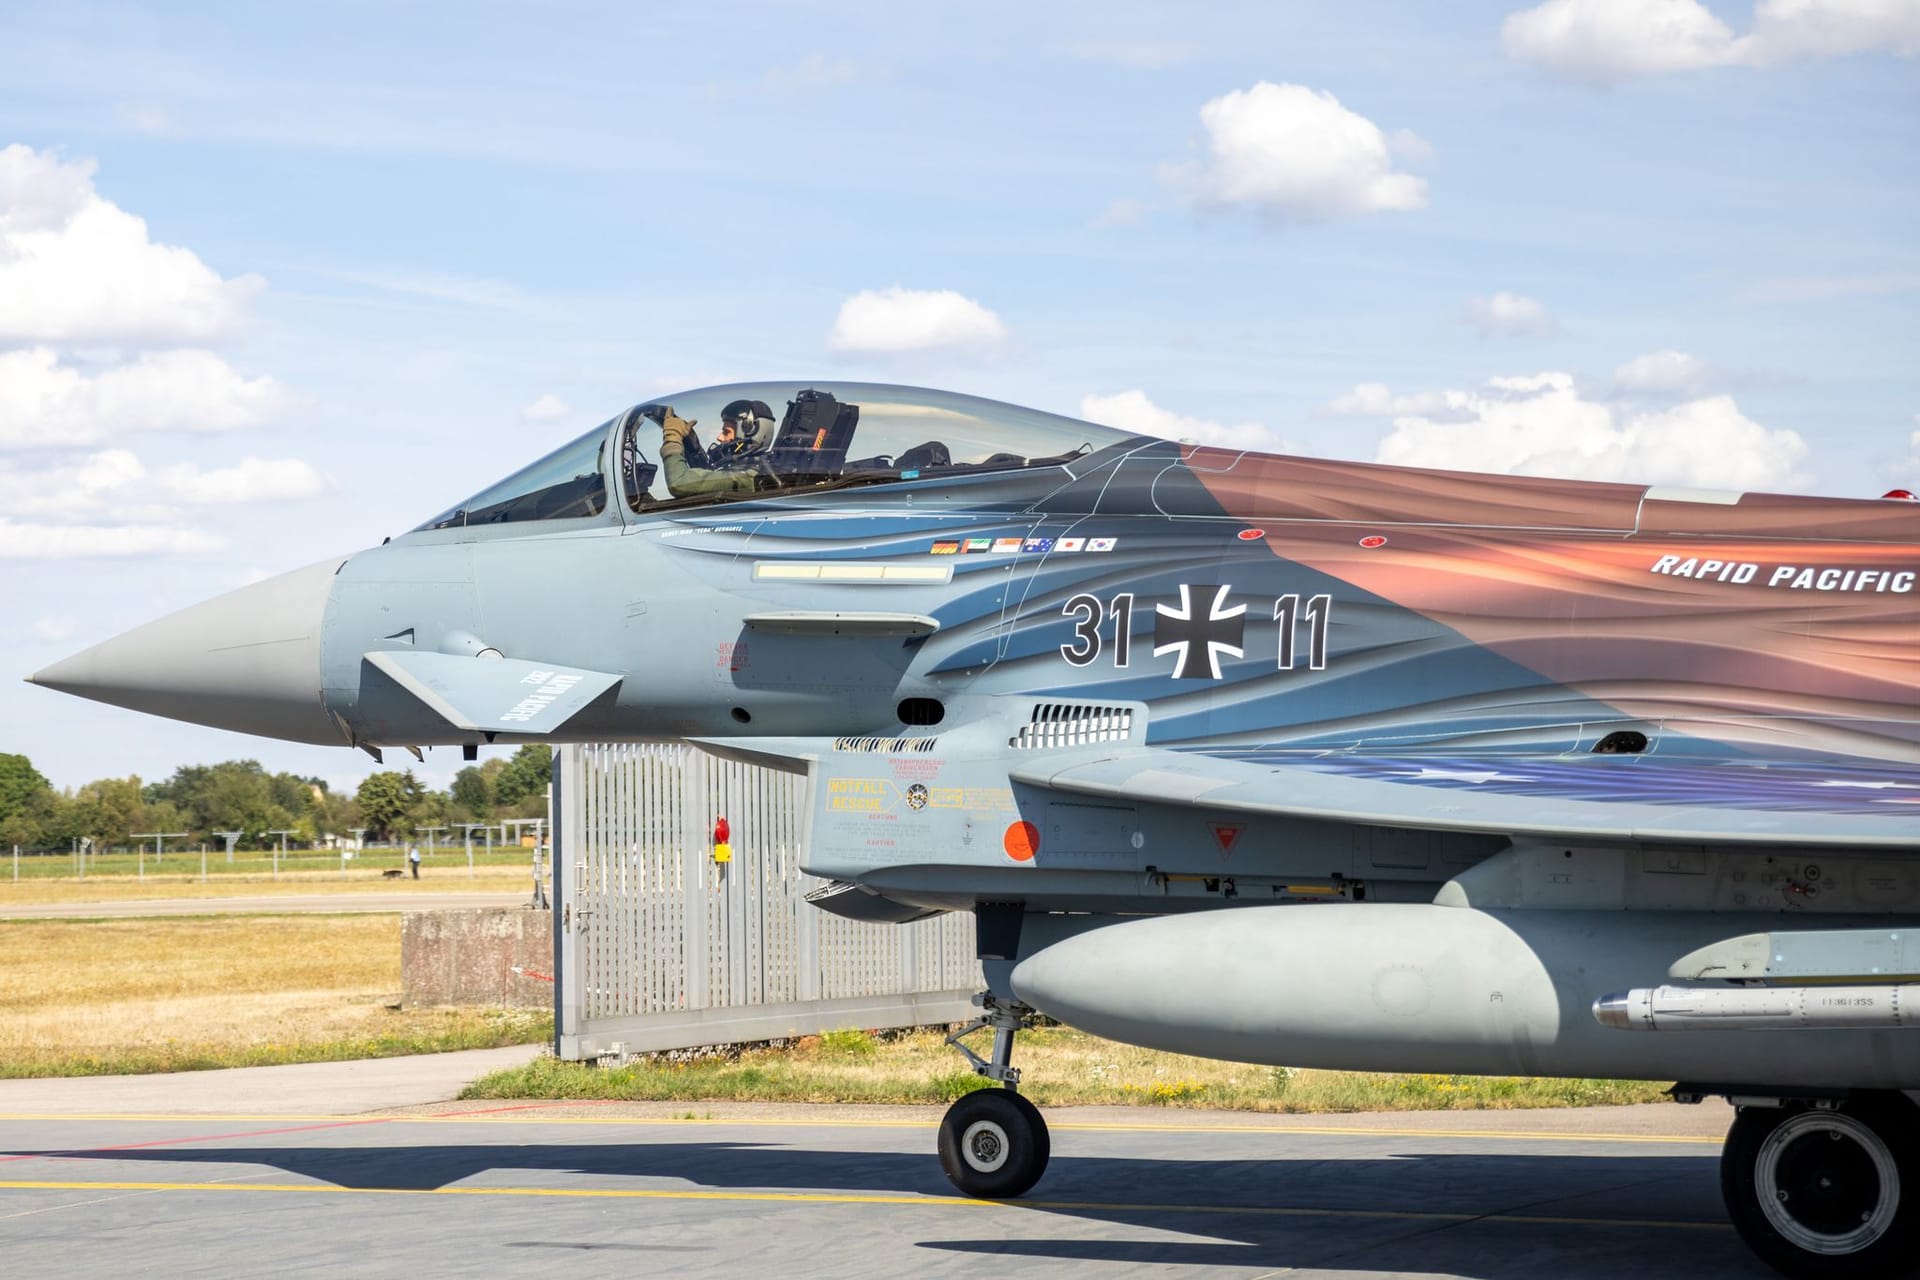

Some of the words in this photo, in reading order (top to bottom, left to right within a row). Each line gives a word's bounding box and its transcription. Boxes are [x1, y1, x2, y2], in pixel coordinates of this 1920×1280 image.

[1651, 554, 1759, 584] RAPID
[1768, 566, 1916, 593] PACIFIC
[1060, 593, 1134, 668] 31
[1273, 594, 1332, 670] 11
[830, 781, 887, 795] NOTFALL
[832, 796, 883, 810] RESCUE
